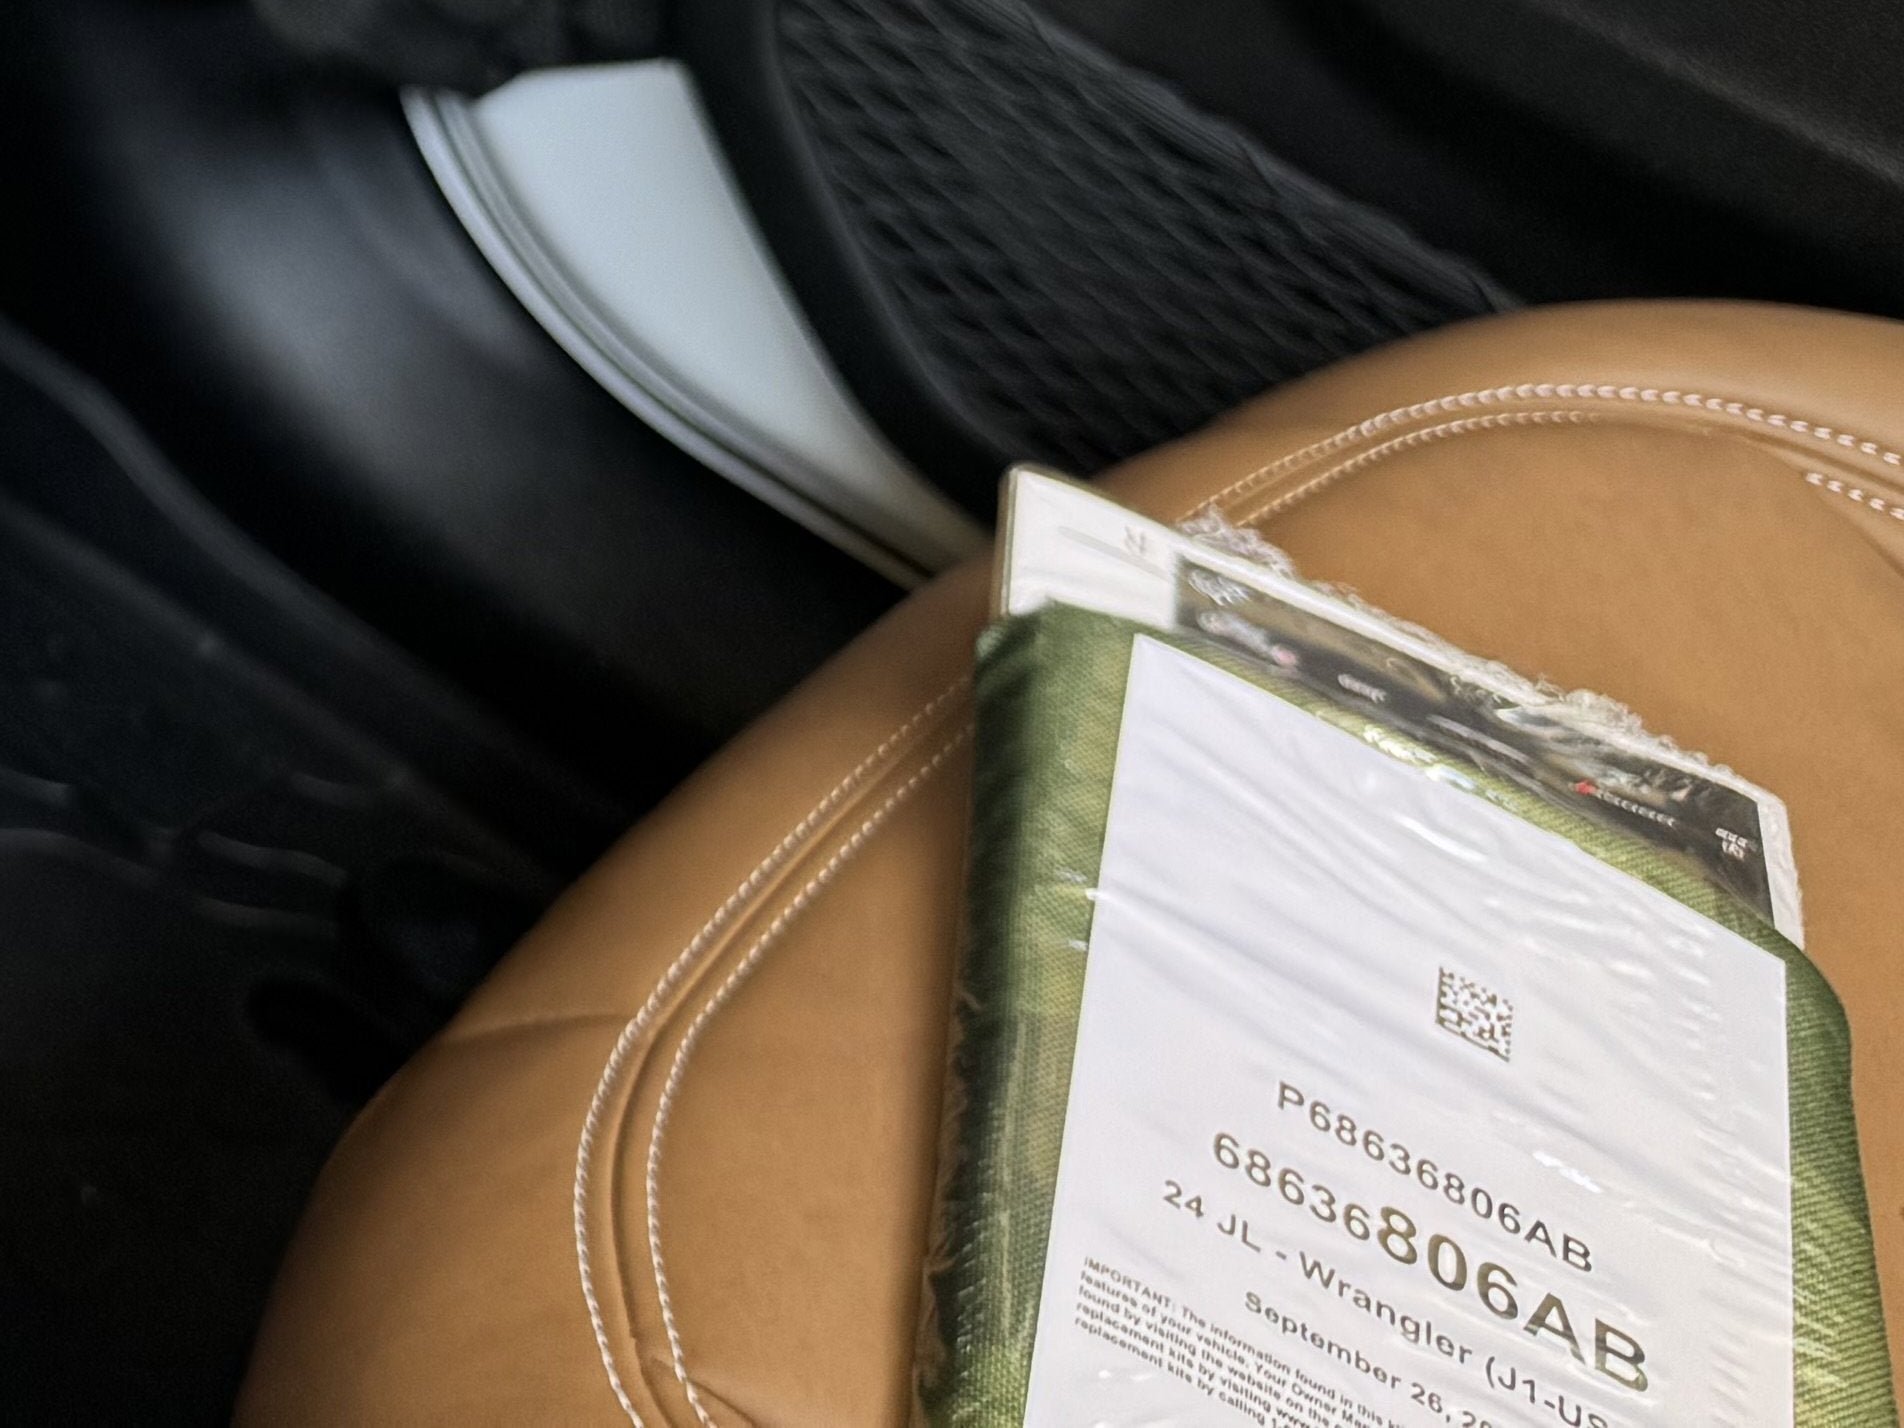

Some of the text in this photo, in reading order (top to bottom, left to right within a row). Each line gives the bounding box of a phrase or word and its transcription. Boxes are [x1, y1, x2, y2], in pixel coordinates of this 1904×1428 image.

[1277, 1080, 1593, 1273] P68636806AB
[1162, 1179, 1205, 1222] 24
[1217, 1214, 1262, 1253] JL
[1298, 1250, 1473, 1365] Wrangler
[1212, 1132, 1650, 1393] 68636806AB
[1075, 1317, 1164, 1369] replacement
[1197, 1378, 1214, 1396] by
[1219, 1391, 1265, 1427] calling
[1076, 1302, 1165, 1353] replacement
[1198, 1362, 1215, 1382] by
[1220, 1373, 1272, 1413] visiting
[1078, 1285, 1120, 1313] found
[1124, 1307, 1141, 1326] by
[1145, 1321, 1197, 1357] visiting
[1201, 1349, 1223, 1369] the
[1227, 1363, 1282, 1401] website
[1286, 1396, 1303, 1413] on
[1081, 1270, 1138, 1308] features
[1142, 1303, 1156, 1318] of
[1161, 1313, 1192, 1335] your
[1254, 1362, 1287, 1388] Your
[1292, 1382, 1337, 1414] Owner
[1182, 1305, 1206, 1328] The
[1210, 1323, 1291, 1375] information
[1295, 1368, 1336, 1400] found
[1245, 1291, 1401, 1389] September
